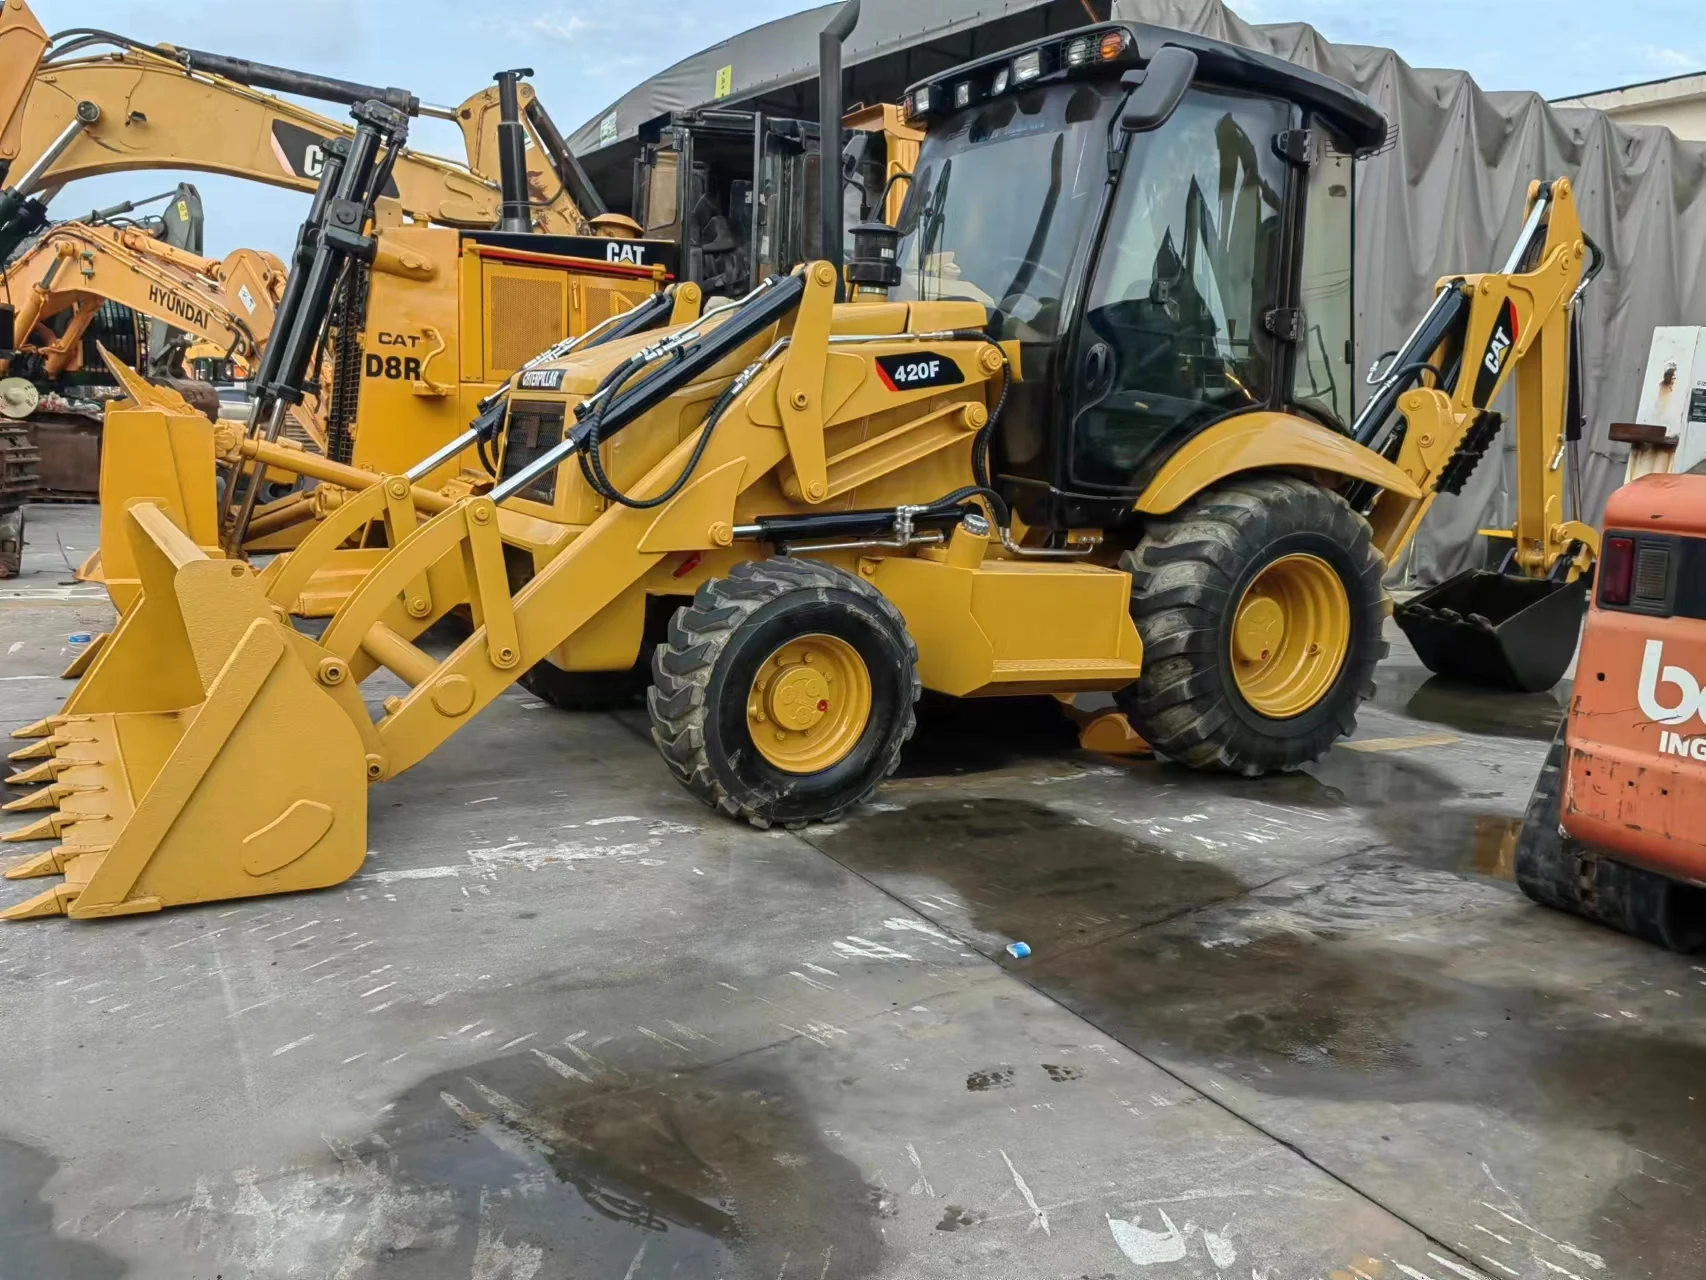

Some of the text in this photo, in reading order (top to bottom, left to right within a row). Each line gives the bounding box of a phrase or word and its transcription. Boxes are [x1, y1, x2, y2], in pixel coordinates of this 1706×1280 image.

[606, 241, 646, 266] CAT
[149, 284, 209, 330] HYUNDAI
[378, 331, 421, 348] CAT
[1484, 326, 1511, 374] CAT
[366, 353, 421, 381] D8R
[894, 360, 940, 382] 420F
[1637, 639, 1706, 725] b
